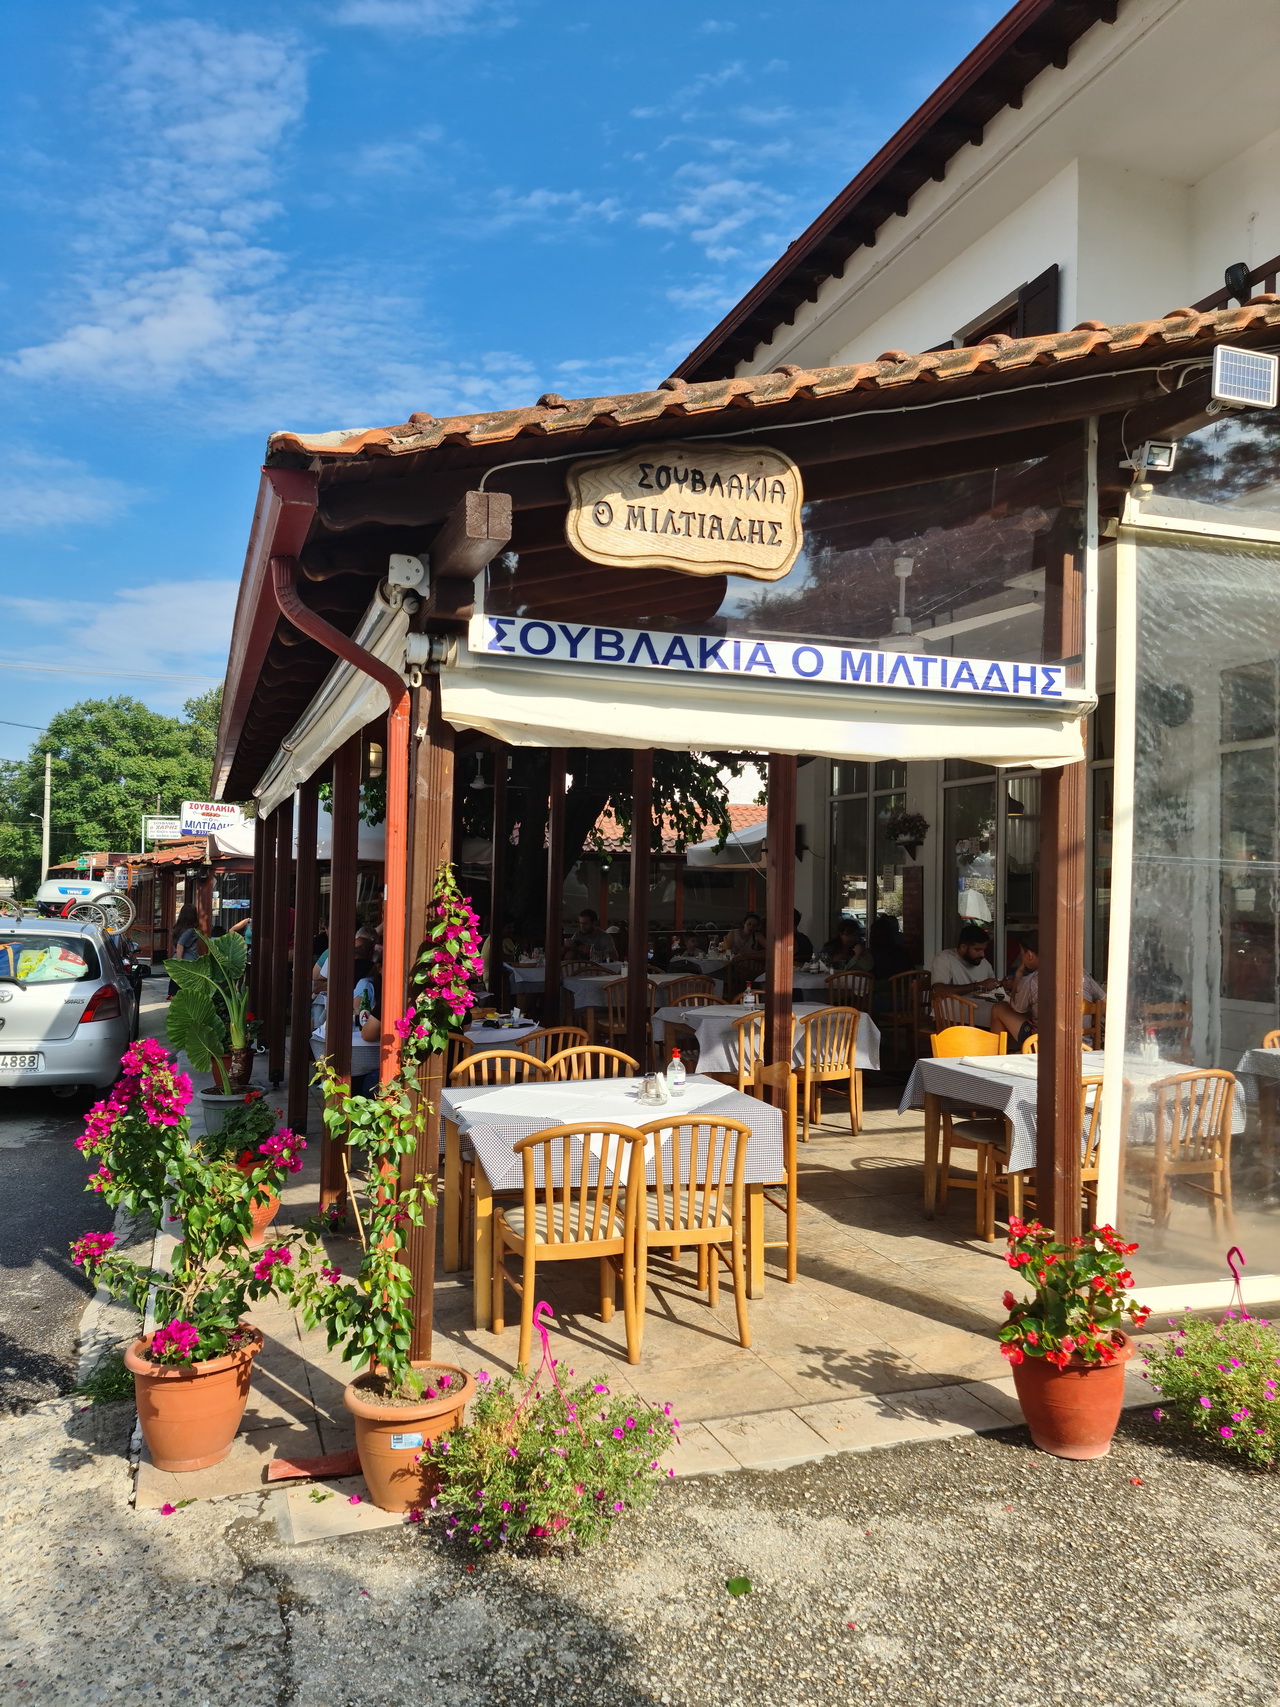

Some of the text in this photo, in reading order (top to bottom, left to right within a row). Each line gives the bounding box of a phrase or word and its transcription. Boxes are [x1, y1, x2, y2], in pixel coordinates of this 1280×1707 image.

[638, 463, 786, 504] ΣΟΥΒΛΑΚΙΑ
[592, 500, 783, 546] Ο ΜΙΛΤΙΑΔΗΣ
[488, 617, 1062, 696] ΣΟΥΒΛΑΚΙΑ Ο ΜΙΛΤΙΑΔΗΣ
[189, 803, 235, 813] ΣΟΥΒΛΑΚΙΑ
[185, 820, 234, 830] ΜΙΛΤΙΑΔ
[1, 1056, 36, 1067] 4888
